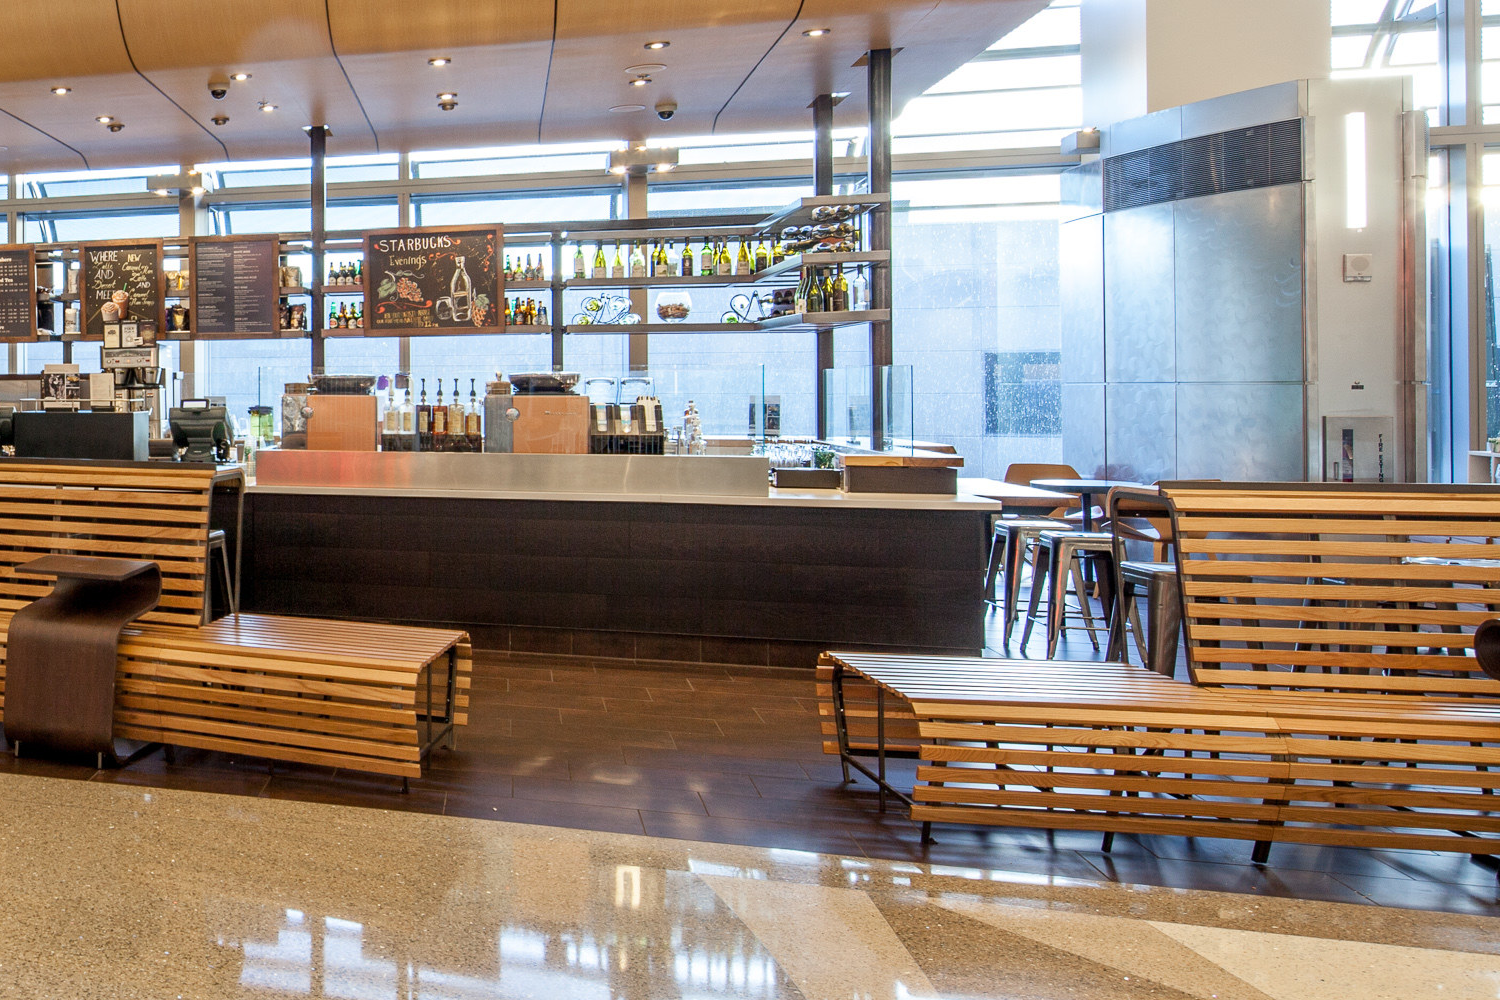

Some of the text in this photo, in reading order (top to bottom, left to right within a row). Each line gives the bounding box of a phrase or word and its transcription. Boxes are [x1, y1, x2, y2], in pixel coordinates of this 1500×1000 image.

[380, 235, 452, 252] STARBUCKS
[89, 251, 119, 263] WHERE
[127, 254, 141, 262] NEW
[389, 255, 427, 270] Evenings
[94, 269, 114, 279] AND
